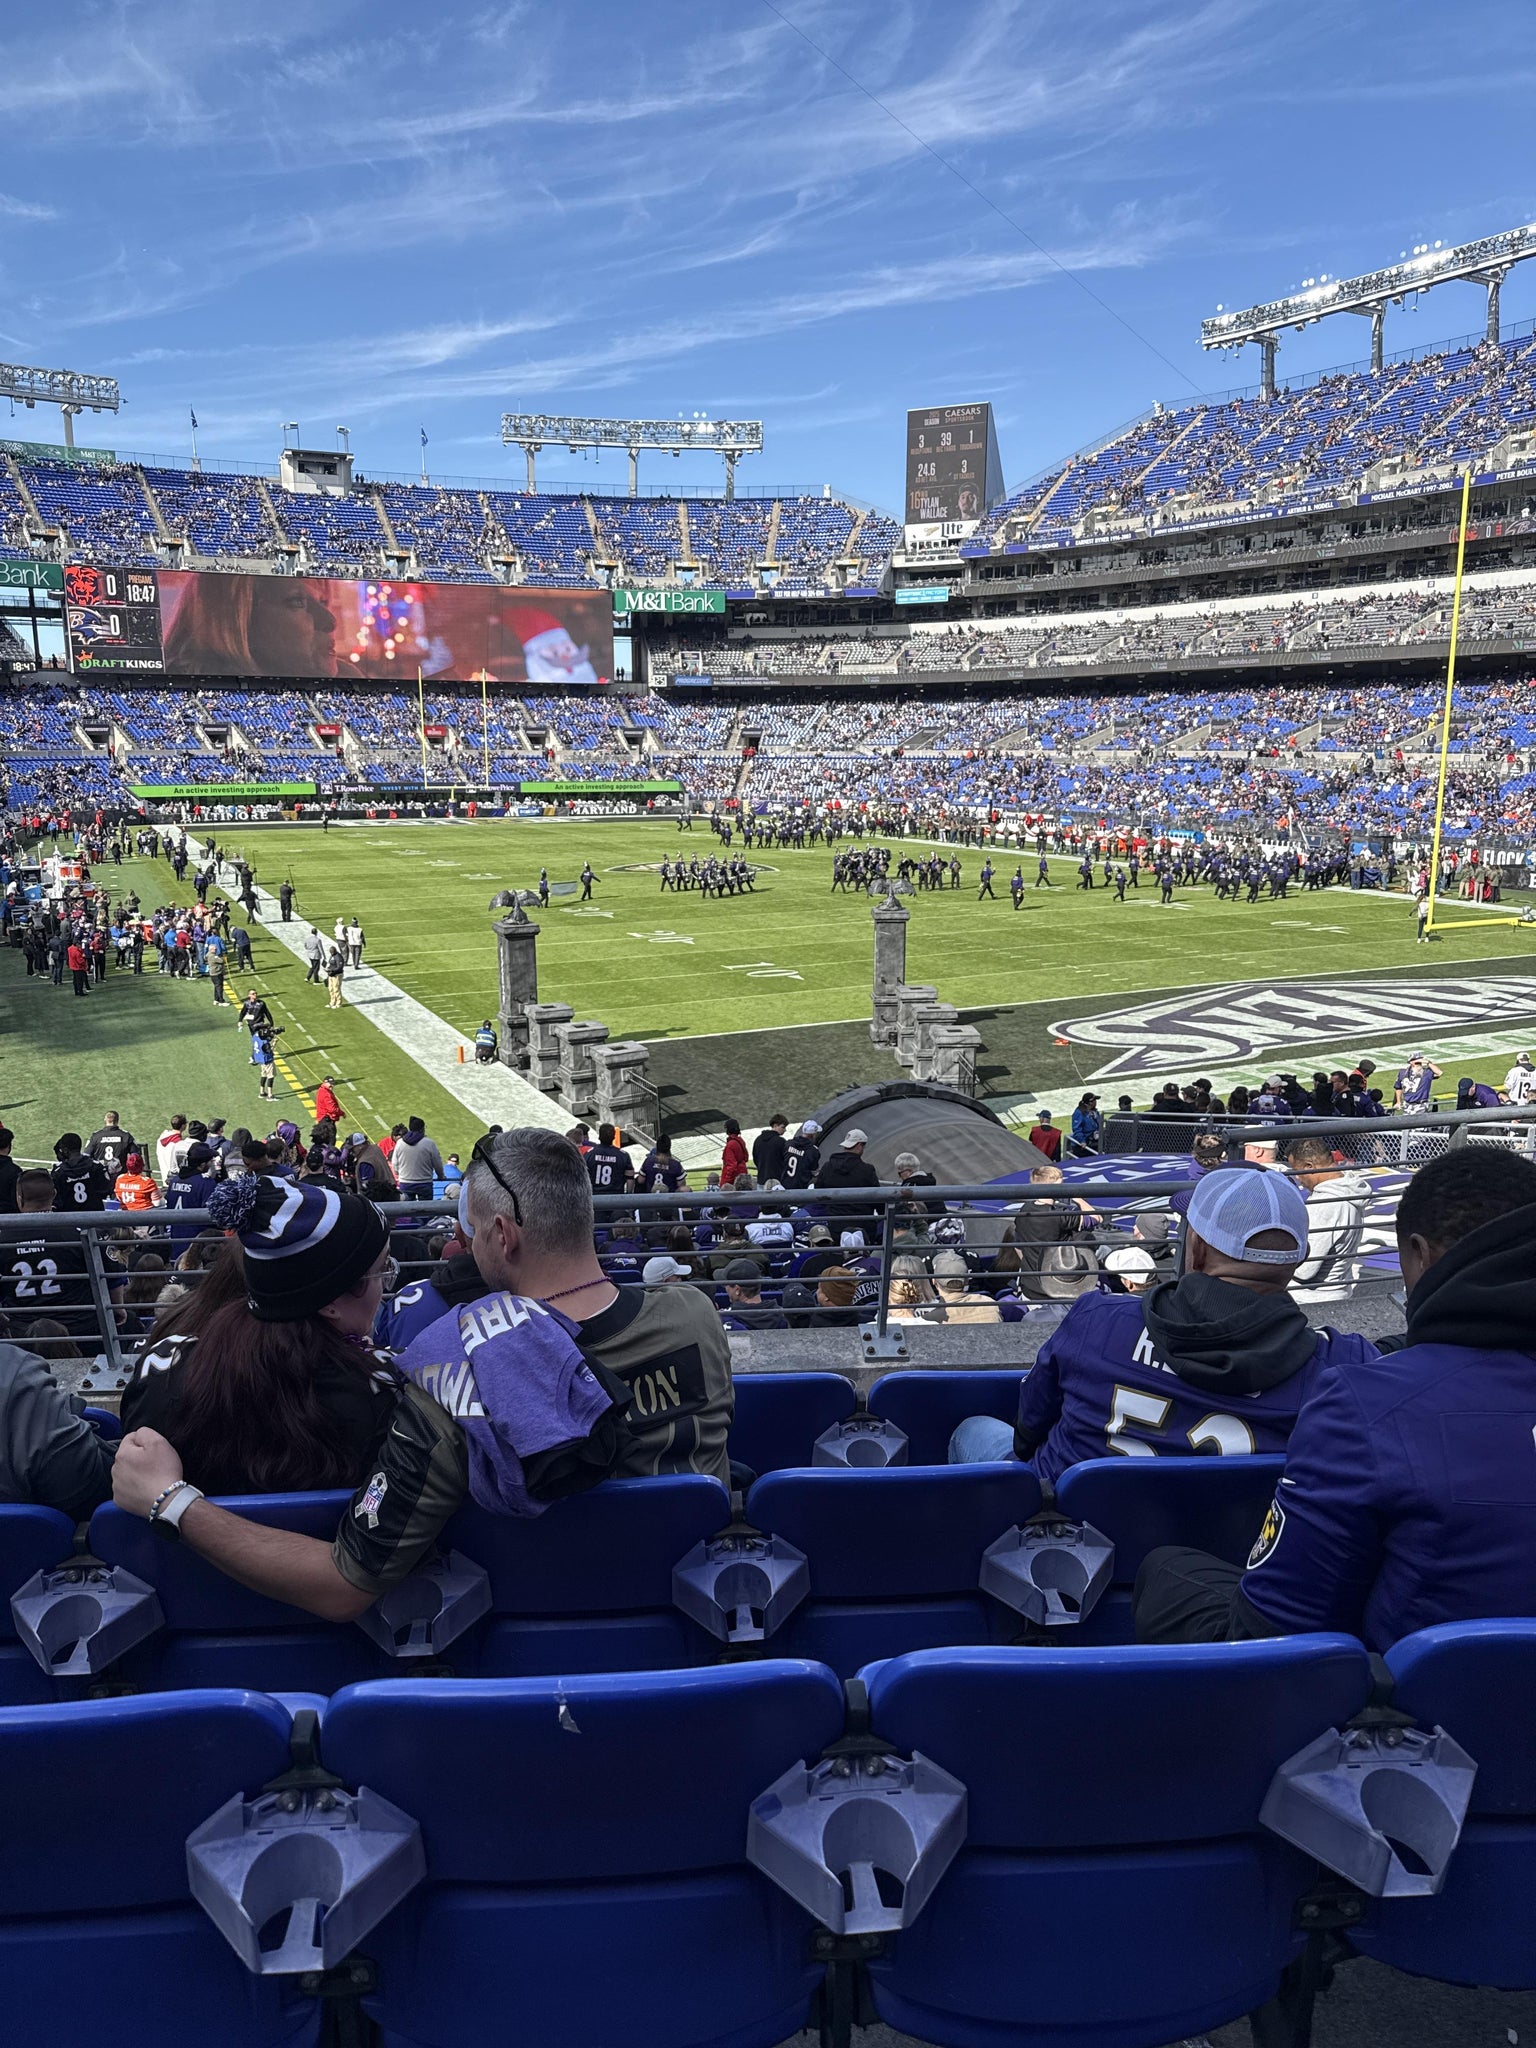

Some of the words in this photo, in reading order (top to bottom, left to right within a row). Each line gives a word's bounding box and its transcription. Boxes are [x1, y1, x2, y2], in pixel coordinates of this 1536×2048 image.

[945, 407, 981, 417] CAESARS
[918, 434, 925, 448] 3
[940, 431, 952, 446] 39
[969, 429, 974, 444] 1
[918, 462, 936, 477] 24.6
[961, 459, 967, 473] 3
[1496, 471, 1516, 480] PETER
[910, 490, 921, 509] 16
[920, 497, 940, 508] TYLAN
[1371, 492, 1395, 501] MICHAEL
[919, 507, 948, 519] WALLACE
[1286, 506, 1307, 515] ARTHUR
[1313, 501, 1334, 510] MODELL
[941, 523, 963, 539] Lite
[106, 574, 117, 596] 0
[128, 574, 153, 584] PREGAME
[126, 584, 156, 603] 18:47
[624, 591, 671, 611] M&T
[671, 592, 715, 611] Bank
[110, 614, 120, 636] 0
[12, 661, 36, 671] 18:47
[79, 658, 163, 669] DRAFTKINGS
[210, 786, 245, 795] investing
[246, 786, 280, 795] approach
[586, 783, 611, 792] investing
[612, 783, 644, 791] approach
[571, 805, 637, 815] MARYLAND
[105, 1146, 114, 1161] 8
[595, 1154, 616, 1163] WILLIAMS
[787, 1156, 798, 1178] 9
[595, 1164, 612, 1185] 18
[73, 1182, 88, 1204] 8
[11, 1258, 62, 1297] 22
